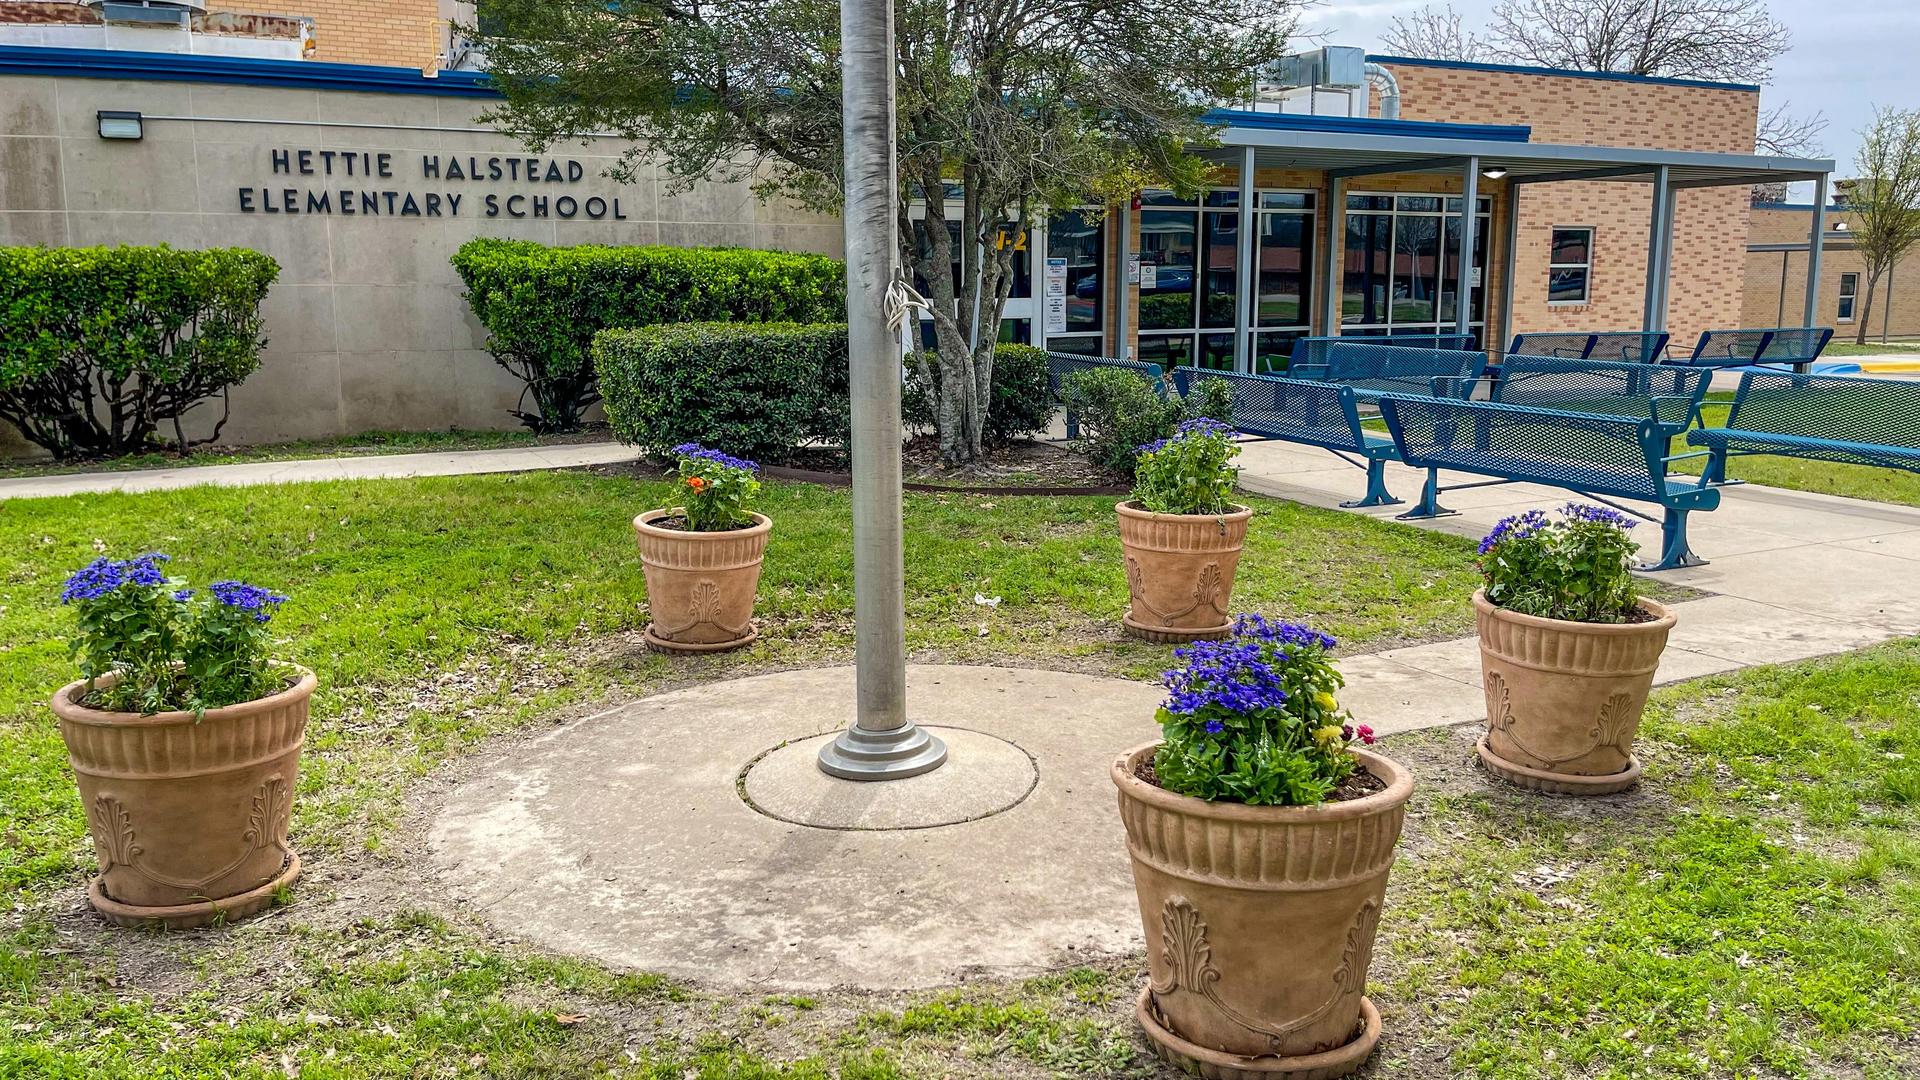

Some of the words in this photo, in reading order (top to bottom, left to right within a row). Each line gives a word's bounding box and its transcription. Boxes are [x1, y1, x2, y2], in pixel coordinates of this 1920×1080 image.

[271, 149, 393, 178] HETTIE
[423, 155, 584, 183] HALSTEAD
[238, 187, 462, 217] ELEMENTARY
[485, 194, 627, 221] SCHOOL
